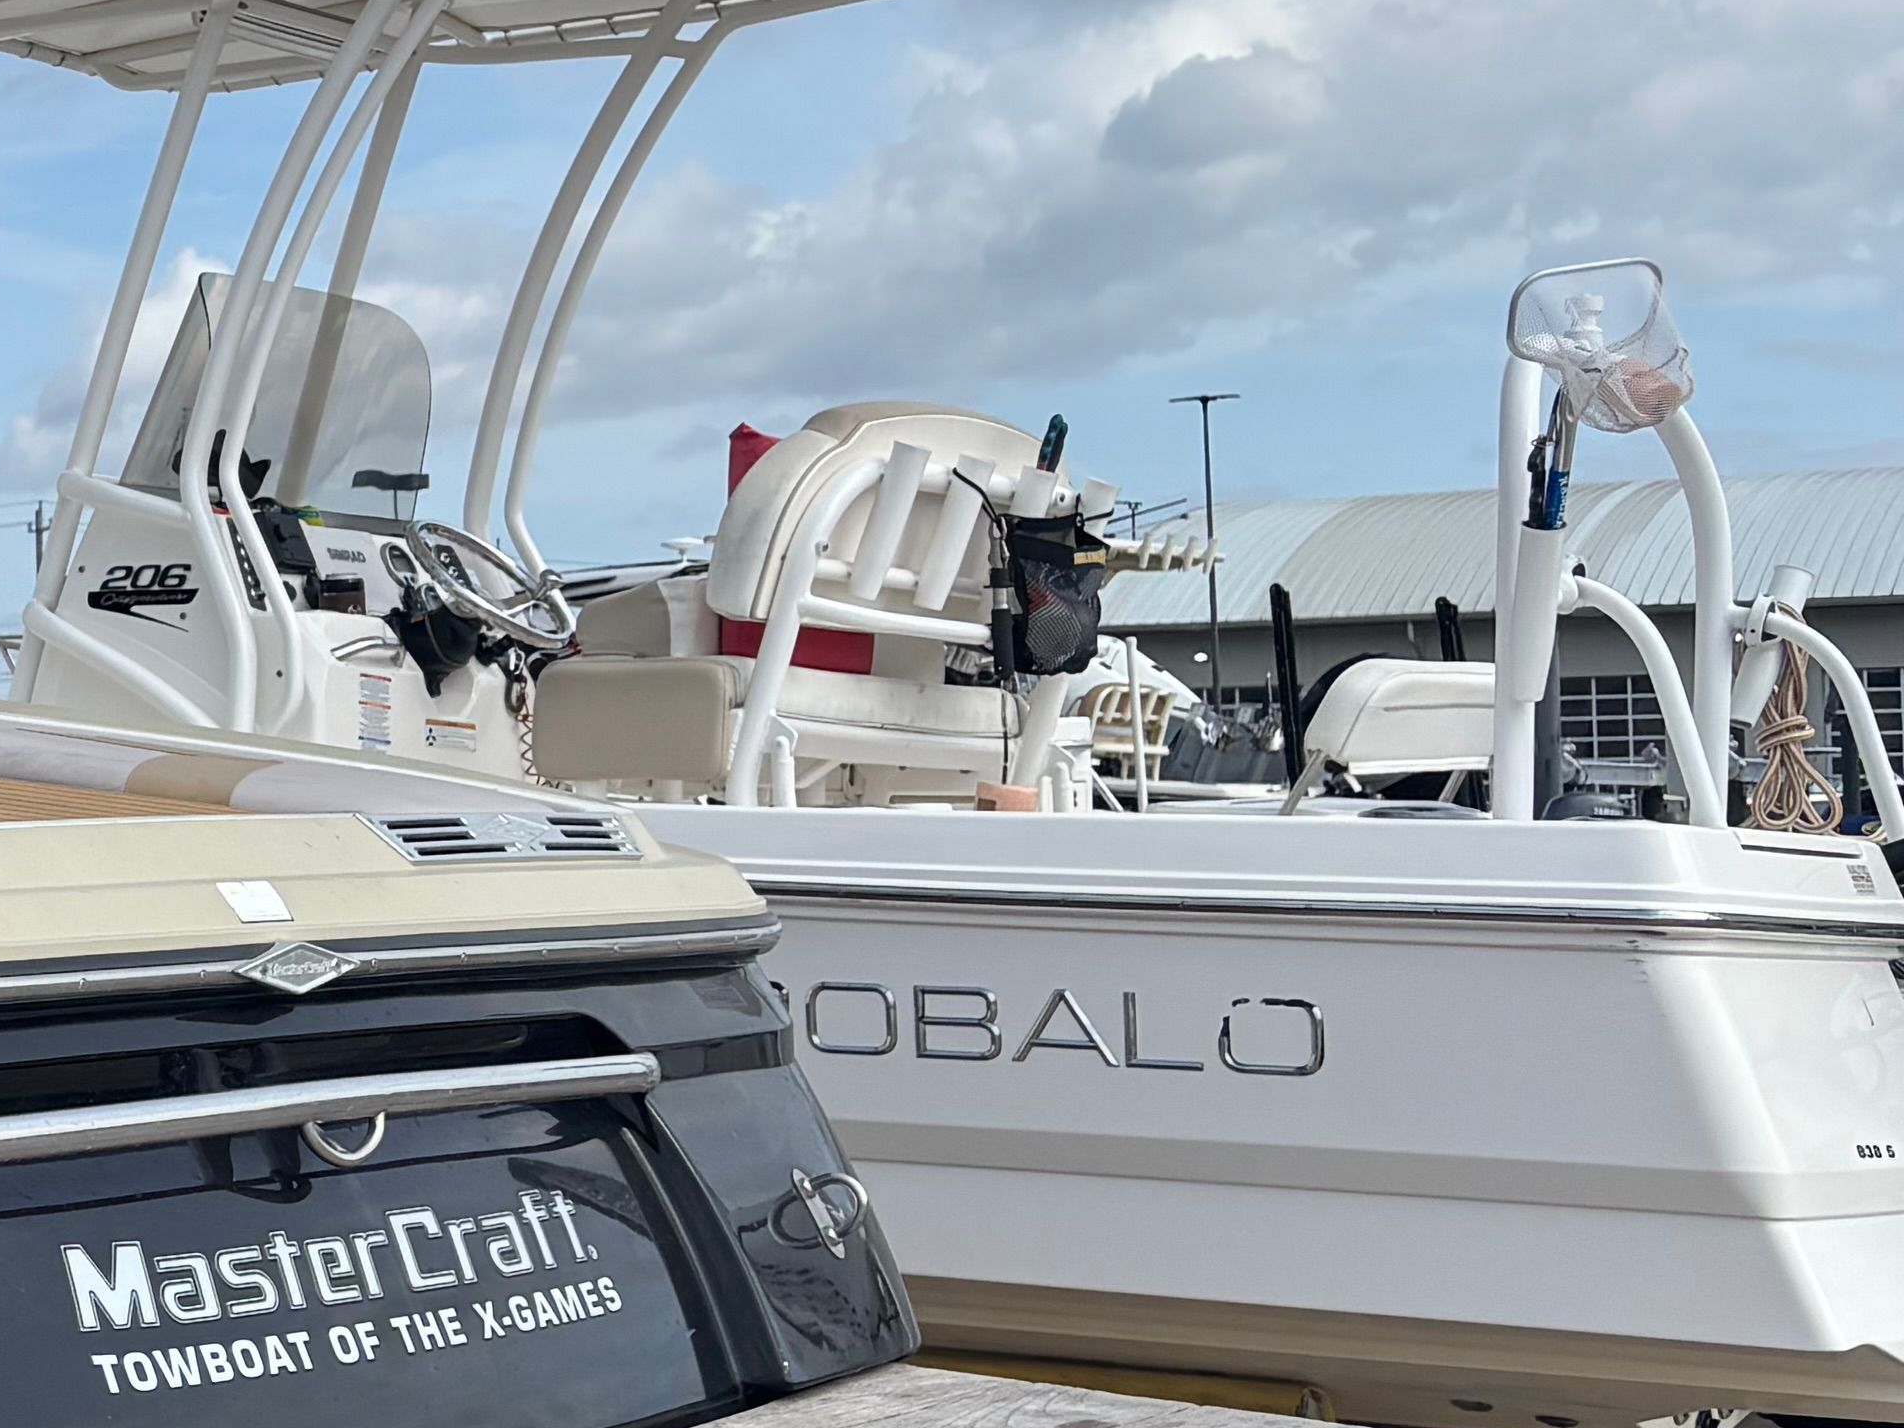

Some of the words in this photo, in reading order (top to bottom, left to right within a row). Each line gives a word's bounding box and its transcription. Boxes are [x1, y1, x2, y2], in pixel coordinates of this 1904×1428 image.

[99, 563, 192, 591] 206
[770, 980, 1325, 1076] OBALO
[92, 1331, 313, 1395] TOWBOAT
[329, 1322, 381, 1366] OF
[391, 1307, 469, 1355] THE
[472, 1275, 623, 1341] X-GAMES
